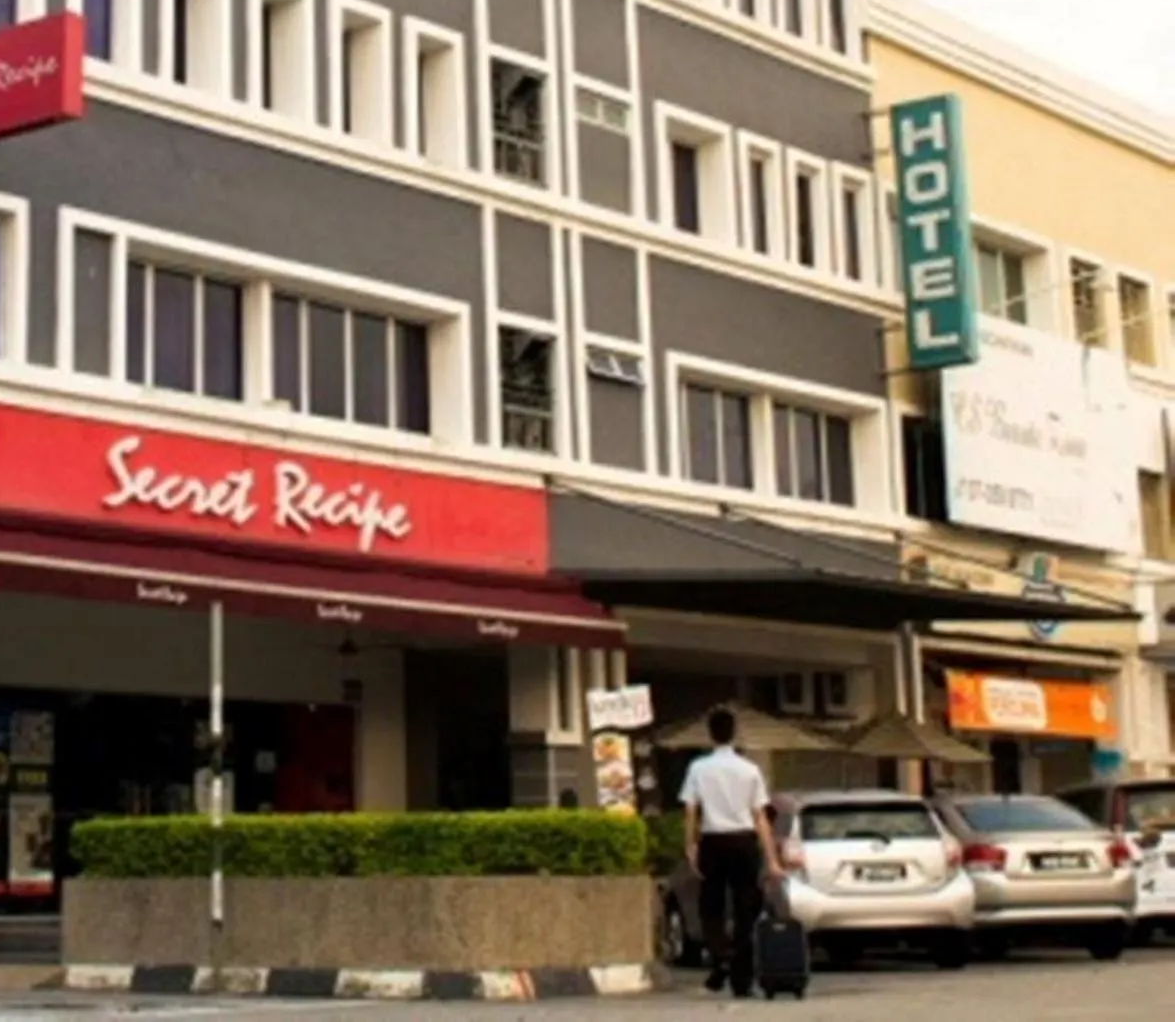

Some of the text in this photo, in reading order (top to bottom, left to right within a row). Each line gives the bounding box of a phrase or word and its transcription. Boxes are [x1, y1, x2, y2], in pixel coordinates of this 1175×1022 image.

[899, 110, 959, 351] HOTEL
[103, 434, 412, 554] Secret Recipe
